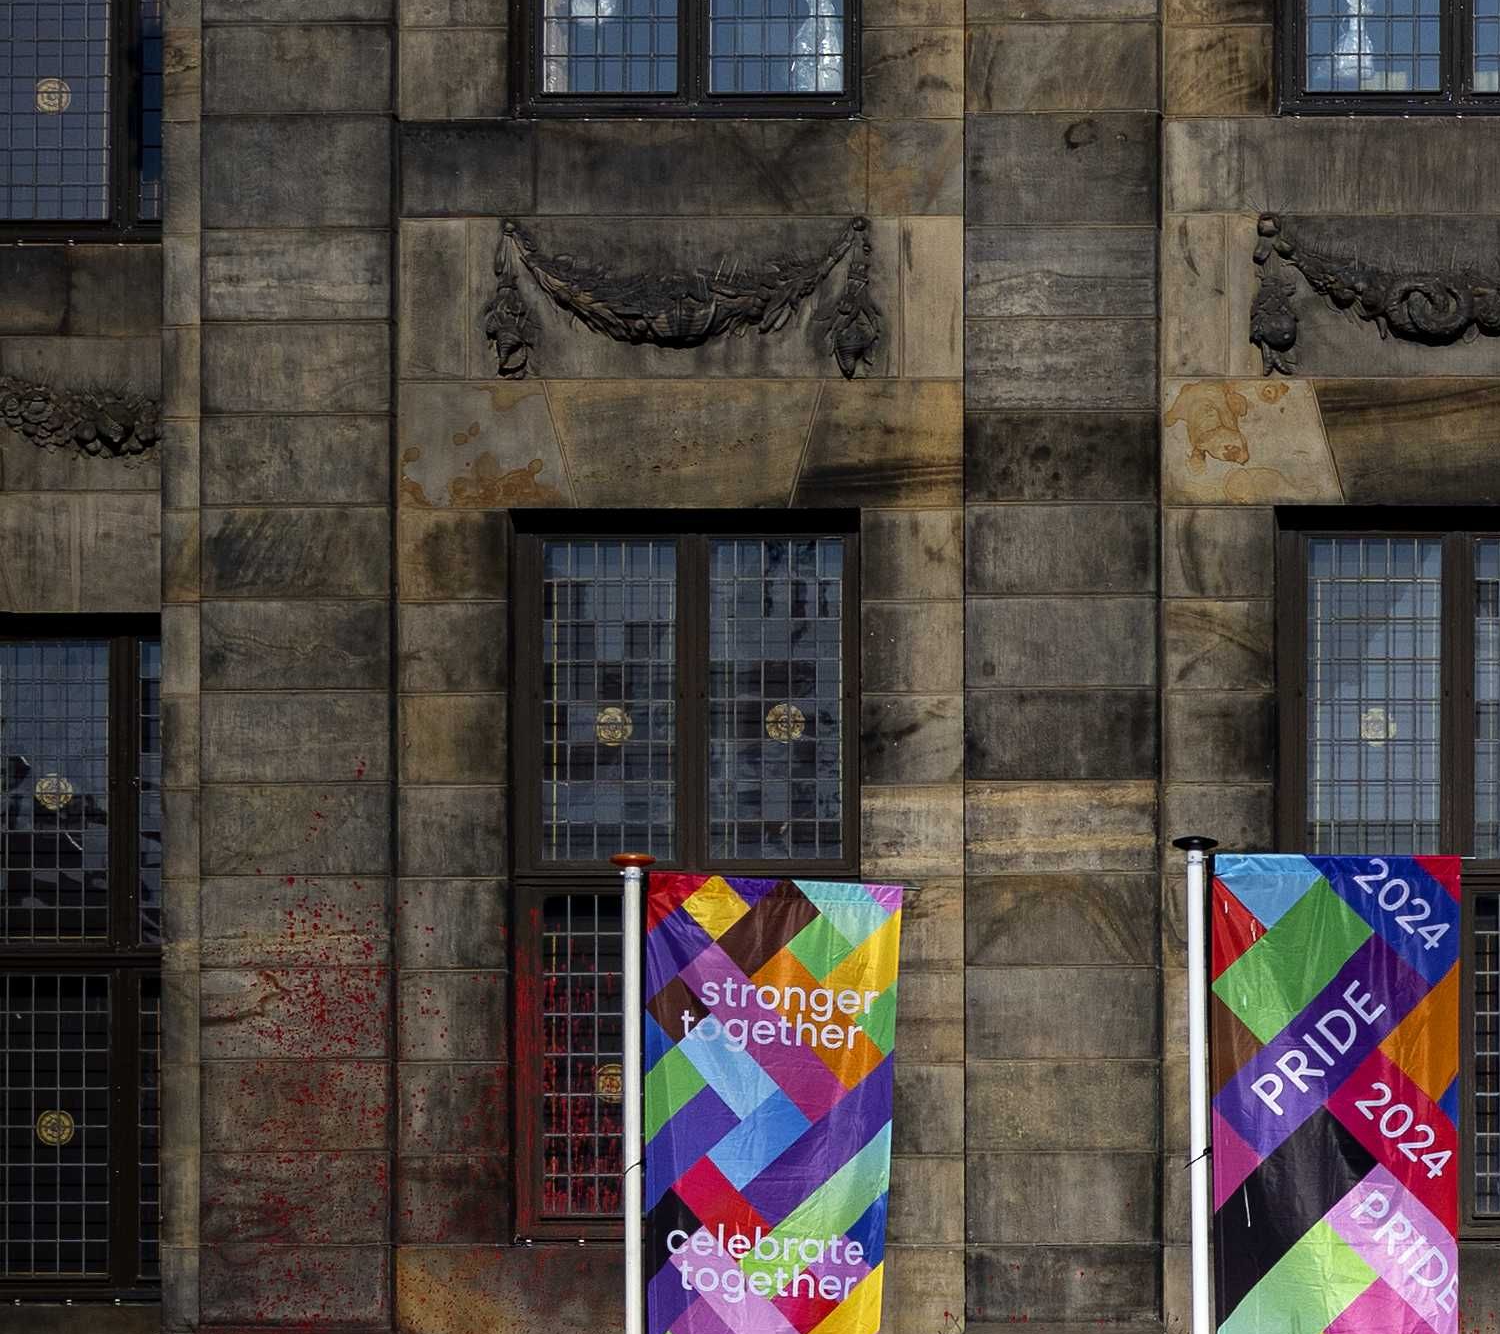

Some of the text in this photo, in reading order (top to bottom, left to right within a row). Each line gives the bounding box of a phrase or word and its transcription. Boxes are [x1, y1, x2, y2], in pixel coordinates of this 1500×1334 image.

[1353, 858, 1450, 950] 2024
[701, 977, 880, 1022] stronger
[681, 1010, 862, 1052] together
[1250, 980, 1386, 1115] PRIDE
[1355, 1082, 1452, 1179] 2024
[667, 1223, 864, 1266] celebrate
[680, 1260, 857, 1303] together
